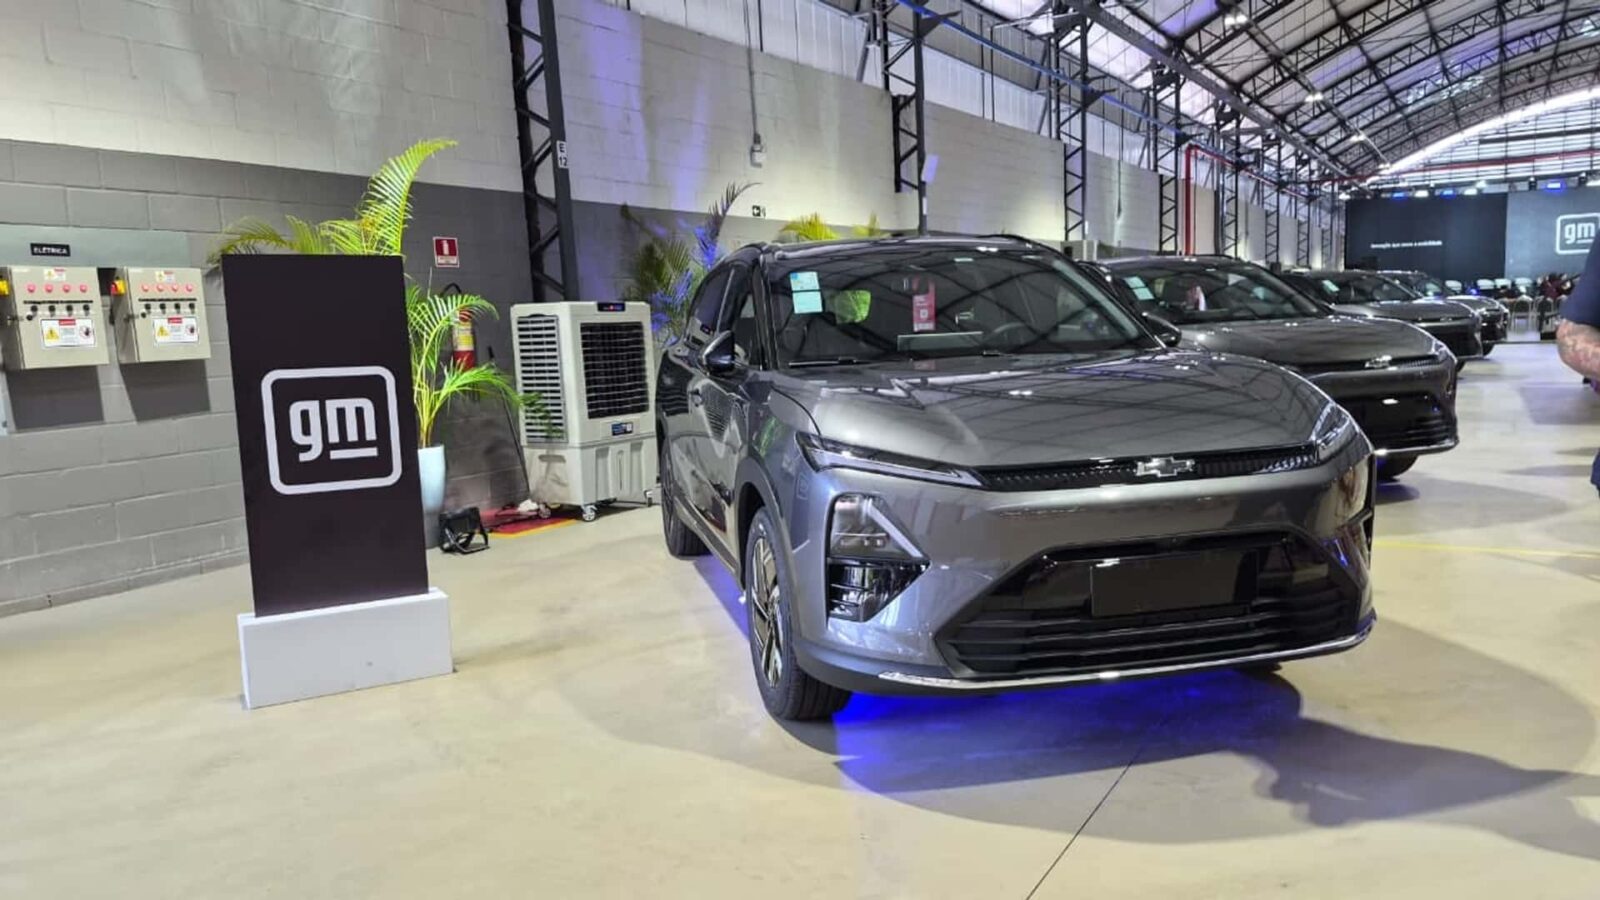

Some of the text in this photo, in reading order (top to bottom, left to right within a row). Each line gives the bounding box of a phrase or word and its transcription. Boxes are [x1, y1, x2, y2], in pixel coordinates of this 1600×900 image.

[559, 142, 566, 153] E
[559, 156, 568, 167] 12
[1564, 222, 1596, 244] gm
[289, 398, 377, 462] gm
